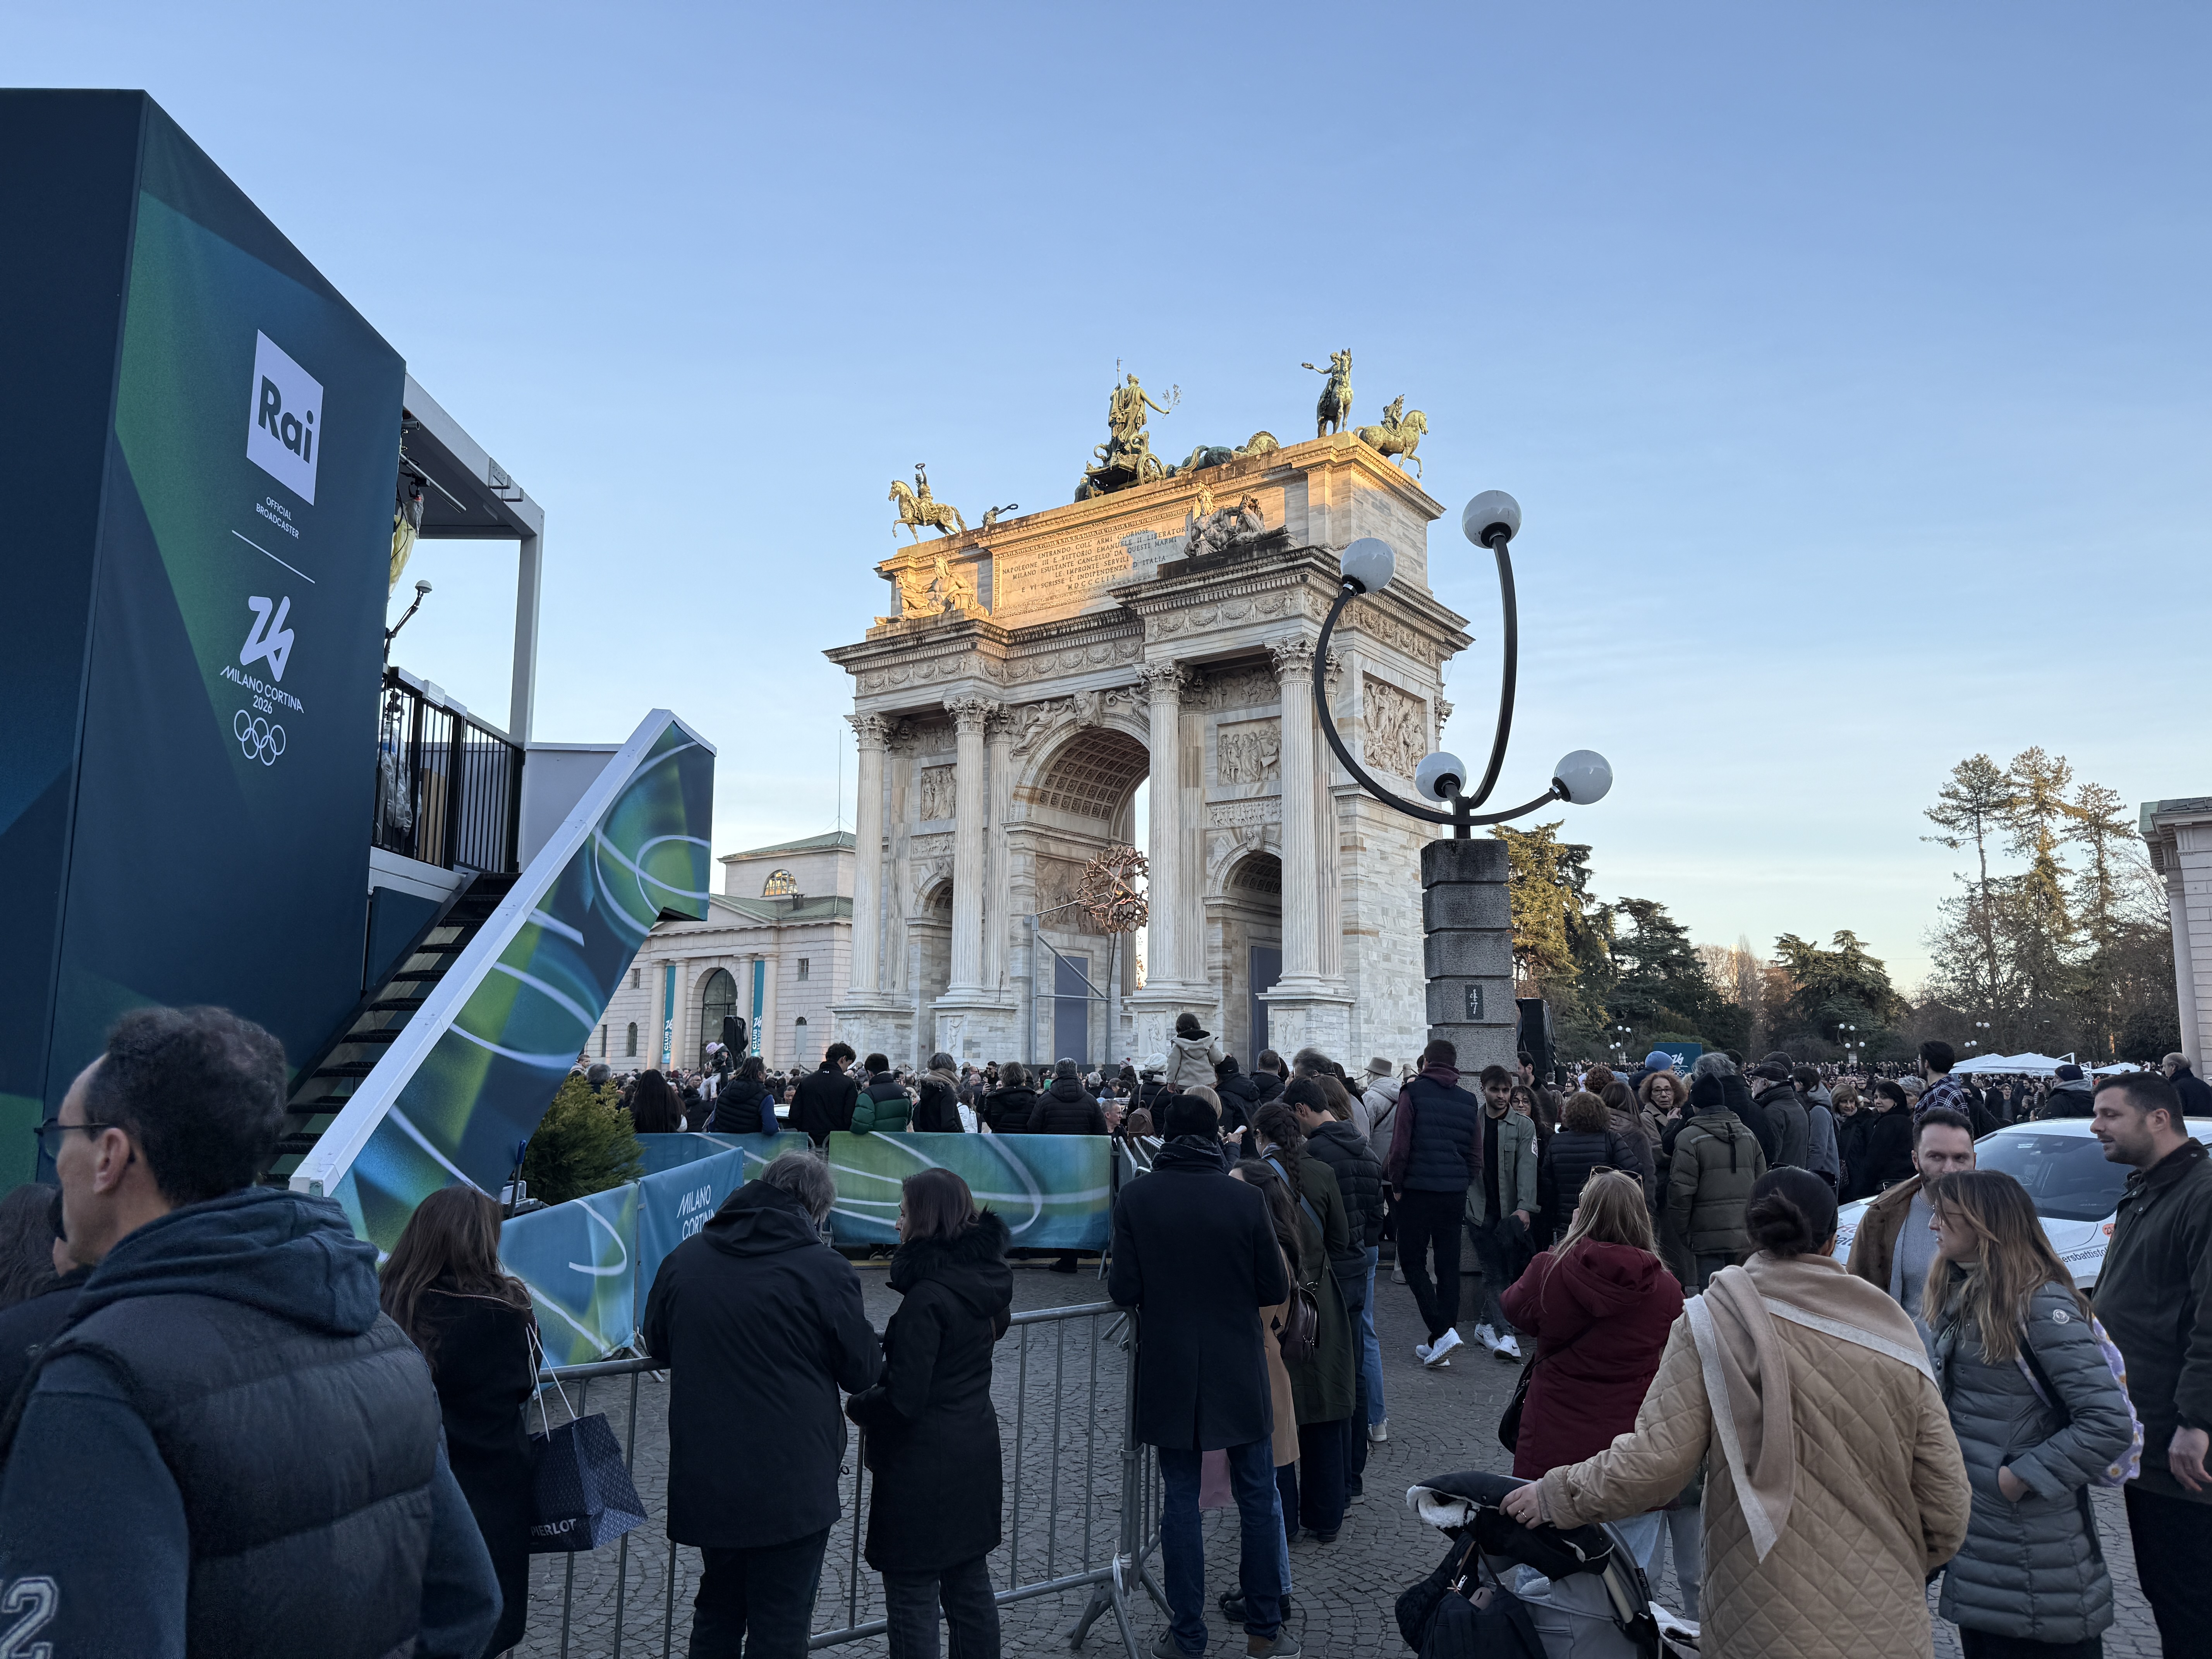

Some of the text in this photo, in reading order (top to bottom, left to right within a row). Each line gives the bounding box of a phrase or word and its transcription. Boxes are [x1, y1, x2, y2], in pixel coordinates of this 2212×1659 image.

[258, 374, 314, 464] Rai
[256, 503, 299, 539] BROADCASTER
[266, 496, 292, 521] OFFICIAL
[1003, 562, 1038, 575] NAPOLEONE
[1062, 549, 1092, 561] VITTORIO
[1097, 539, 1132, 553] EMANUELE
[1147, 526, 1188, 541] LIBERATORI
[1013, 570, 1036, 580] MILANO
[1041, 561, 1074, 573] ESULTANTE
[1127, 543, 1150, 553] QUESTI
[1155, 537, 1176, 547] MARMI
[1038, 546, 1071, 559] ENTRANDO
[1097, 536, 1112, 544] ARMI
[1117, 527, 1149, 539] GLORIOSE
[1041, 578, 1065, 589] SCRISSE
[1078, 565, 1127, 580] INDIPENDENZA
[1143, 555, 1166, 565] ITALIA
[1067, 562, 1099, 575] IMPRONTE
[1104, 556, 1129, 567] SERVILI
[220, 665, 304, 713] MILANO CORTINA
[253, 695, 272, 714] 2026
[677, 1184, 711, 1218] MILANO
[531, 1518, 576, 1536] PIERLOT
